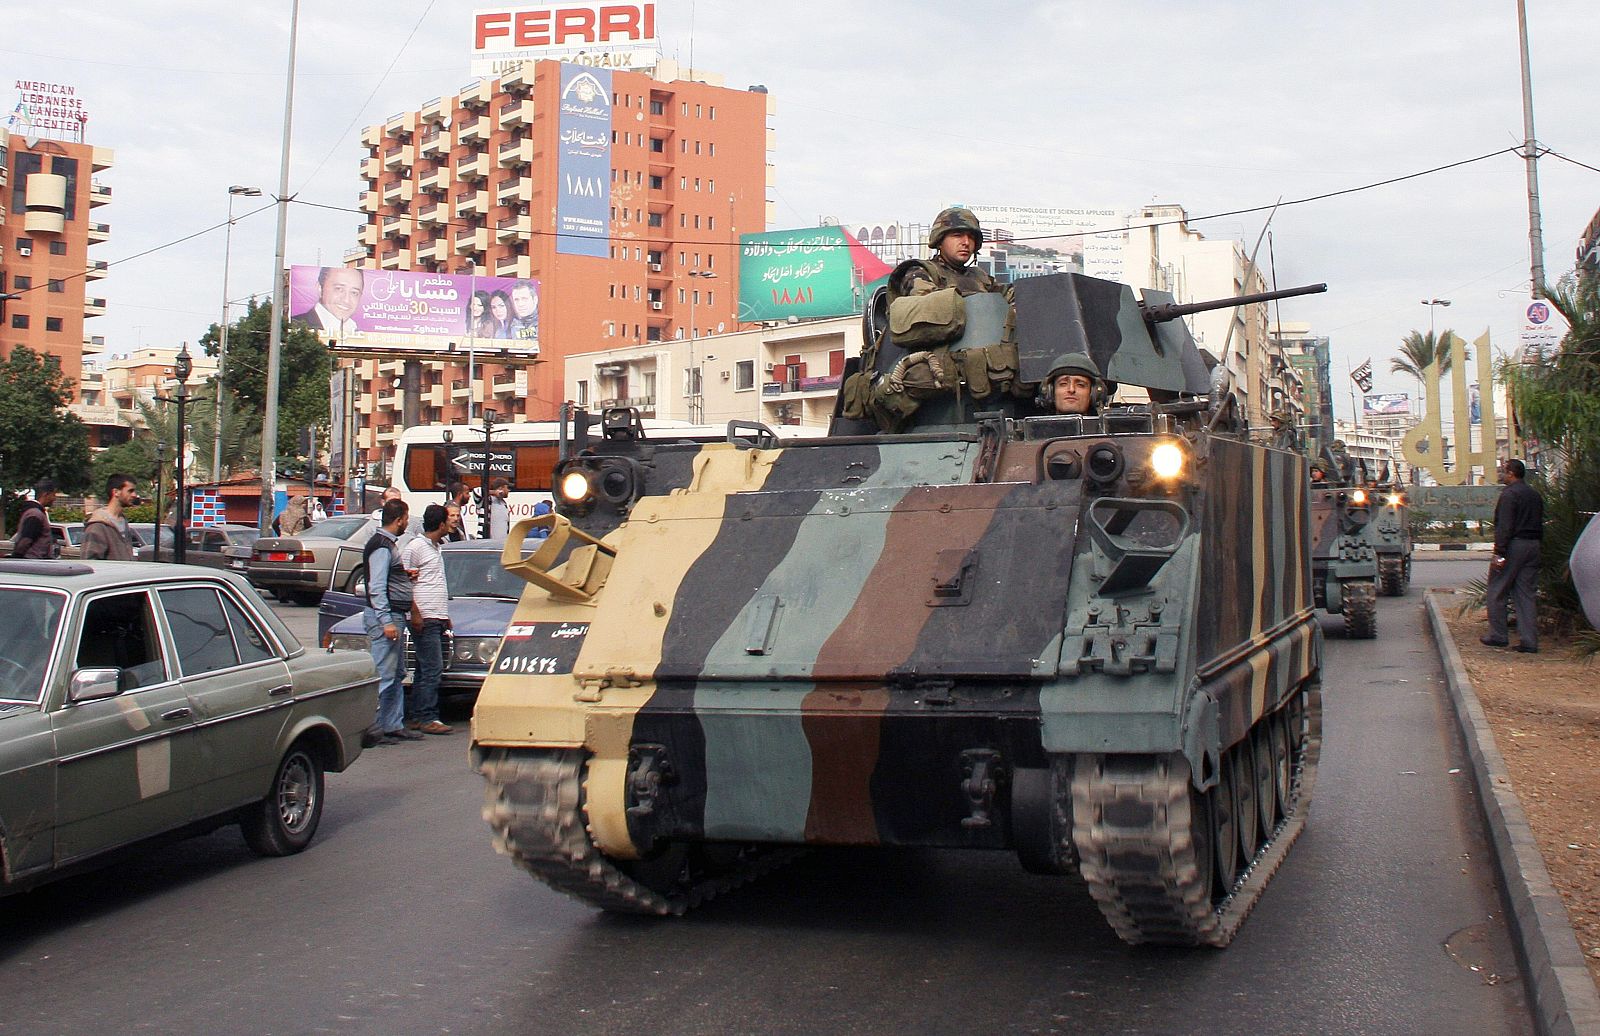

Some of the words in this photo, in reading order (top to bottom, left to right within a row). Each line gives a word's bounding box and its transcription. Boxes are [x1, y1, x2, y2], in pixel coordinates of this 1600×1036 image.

[475, 3, 655, 49] FERRI
[15, 80, 75, 96] AMERICAN
[22, 93, 83, 109] LEBANESE
[29, 105, 89, 121] LANGUAGE
[36, 118, 80, 132] CENTER
[566, 173, 602, 199] ١٨٨١
[1000, 205, 1008, 213] DE
[1009, 206, 1048, 215] TECHNOLOGIE
[1057, 208, 1084, 216] SCIENCES
[422, 275, 453, 286] مطعم
[399, 279, 458, 301] مسايا
[771, 286, 814, 306] ١٨٨١
[409, 300, 428, 315] 30
[429, 306, 461, 315] السبت
[412, 324, 449, 334] Zgharta
[469, 462, 513, 472] ENTANCE
[551, 622, 589, 638] الجيش
